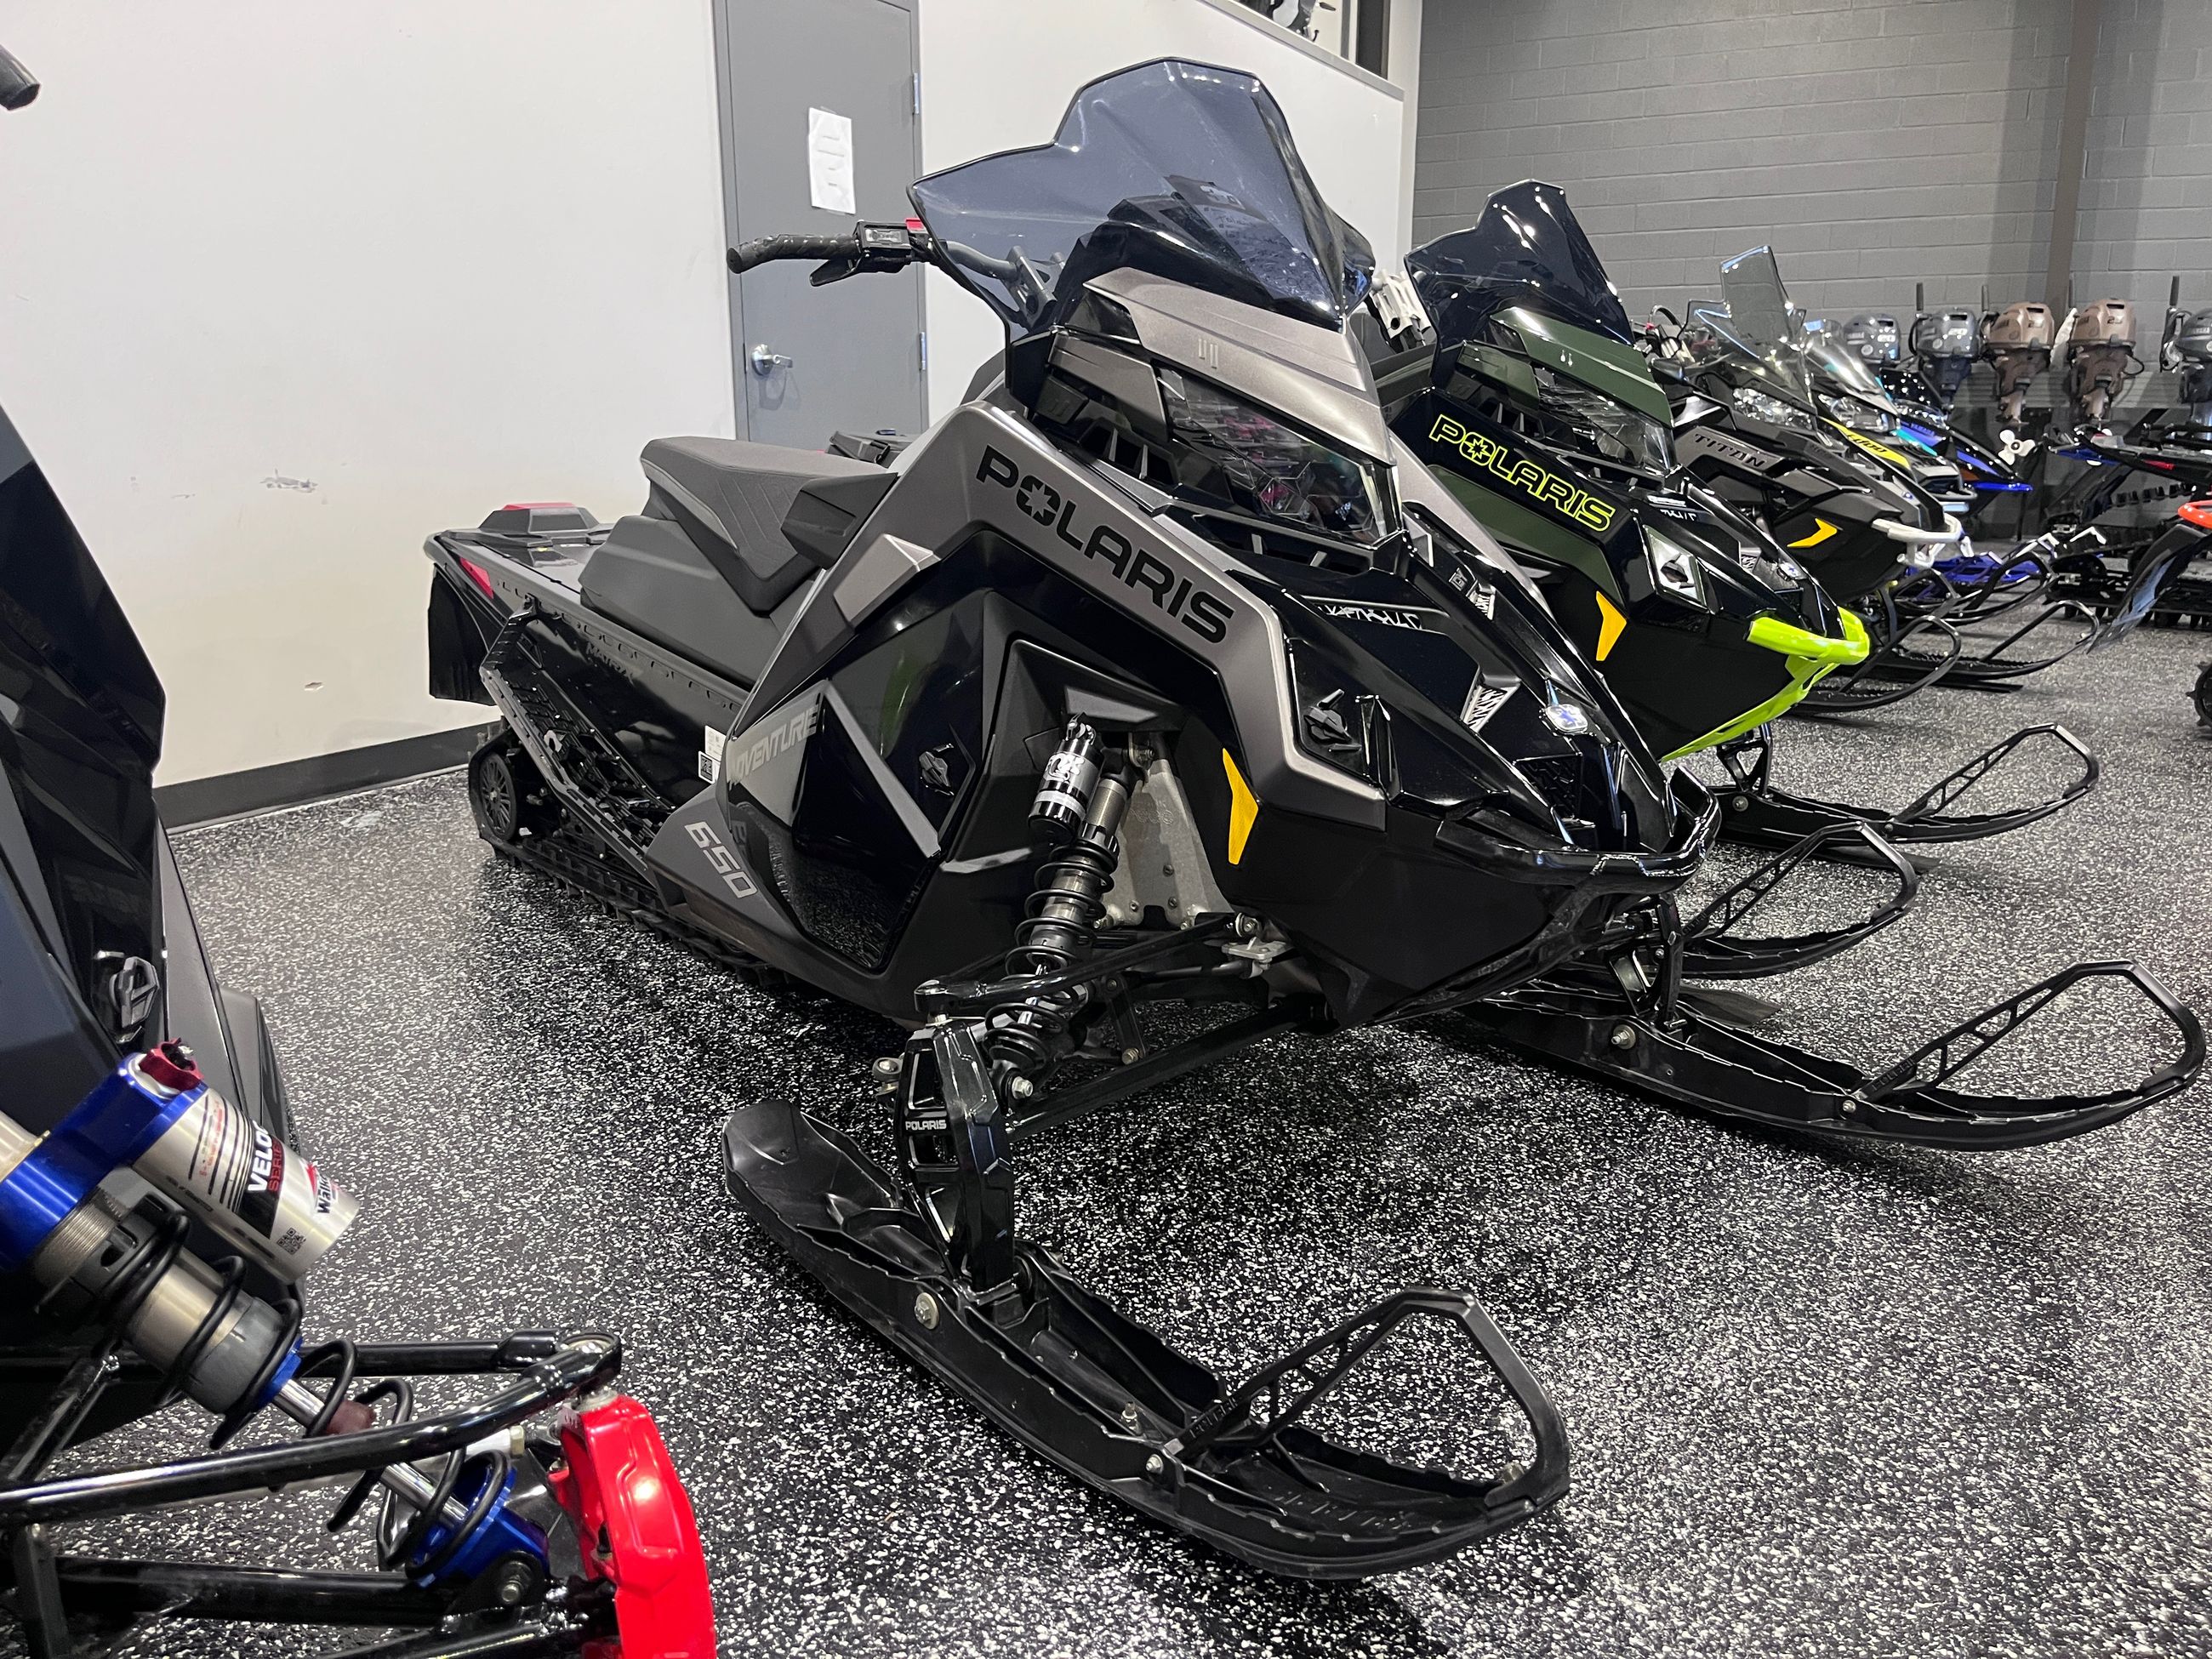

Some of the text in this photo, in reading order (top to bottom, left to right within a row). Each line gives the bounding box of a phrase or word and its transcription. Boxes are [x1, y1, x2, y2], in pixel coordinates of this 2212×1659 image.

[1428, 413, 1616, 532] POLARIS
[1695, 433, 1766, 467] TITAN
[976, 444, 1236, 644] POLARIS
[683, 821, 759, 898] 650
[904, 1120, 947, 1131] POLARIS
